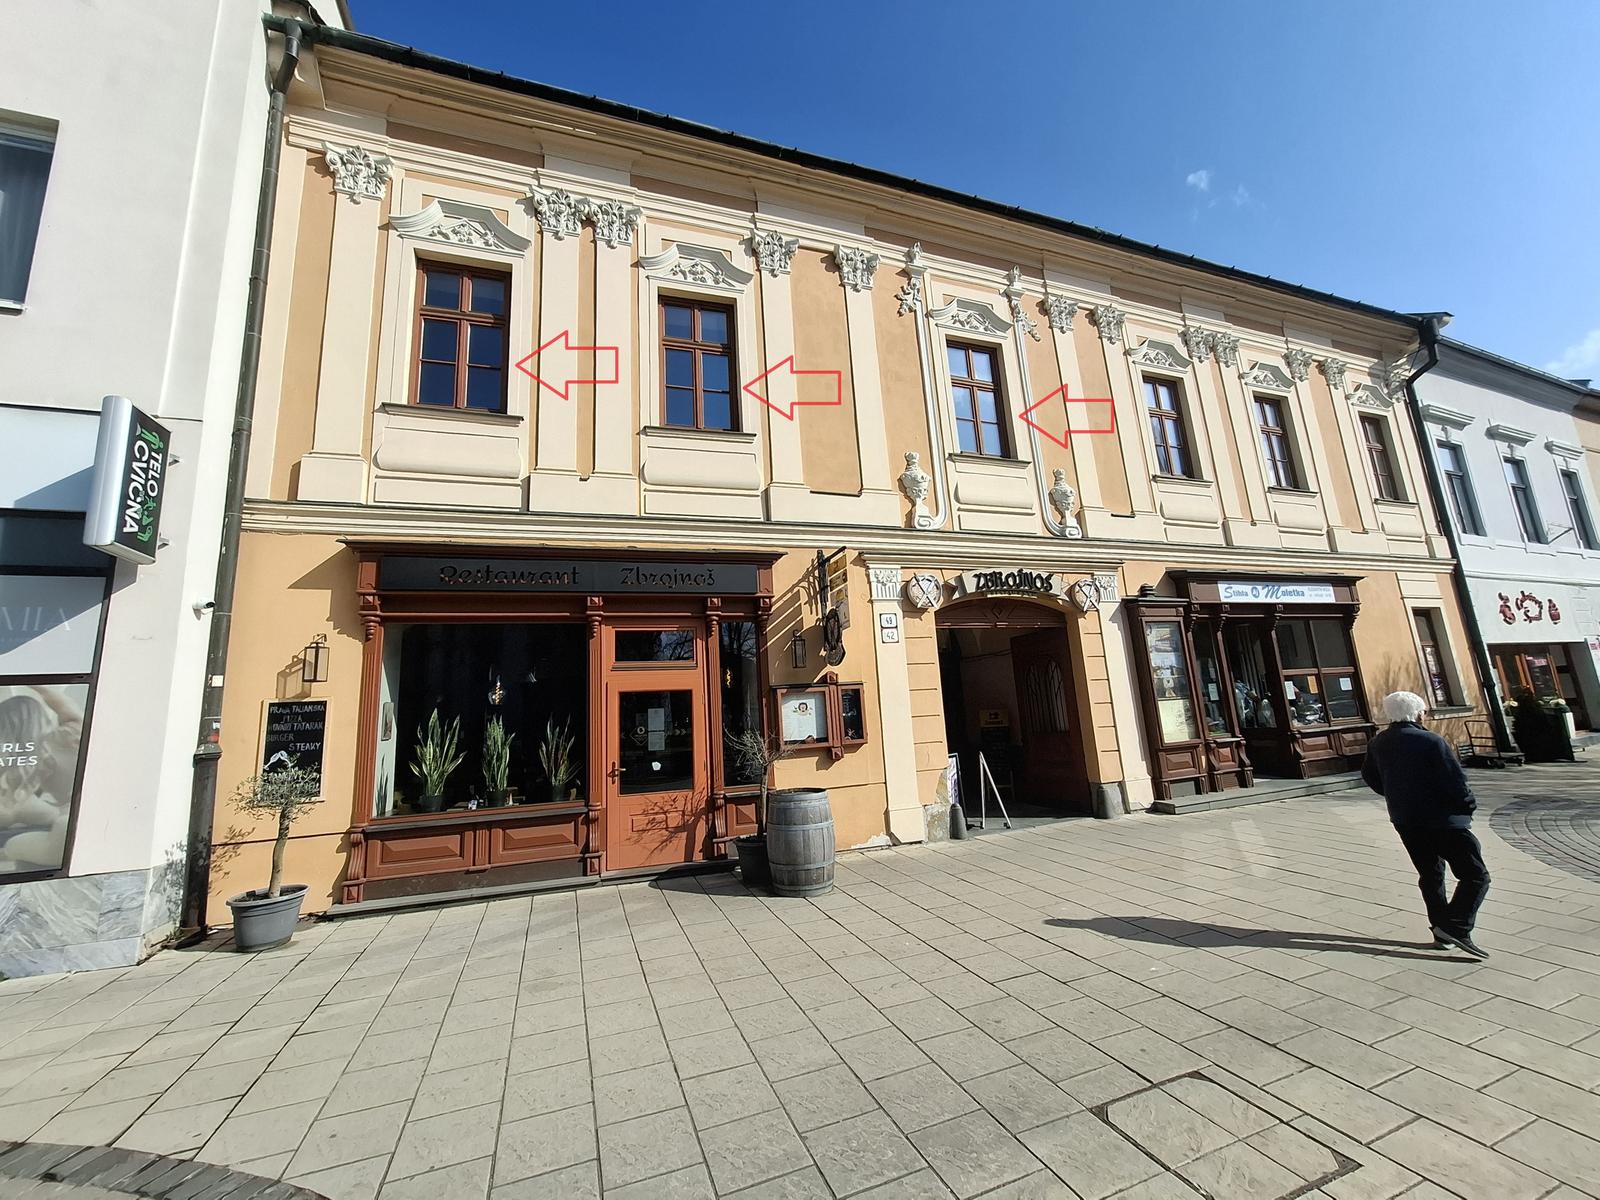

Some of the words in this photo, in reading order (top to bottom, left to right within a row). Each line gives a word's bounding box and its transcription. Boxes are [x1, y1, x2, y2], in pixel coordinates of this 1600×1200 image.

[147, 451, 163, 498] TELO
[440, 564, 580, 586] Restaurant
[620, 566, 716, 589] Zbrojnoš
[886, 631, 896, 640] 42
[289, 743, 321, 751] STEAKY
